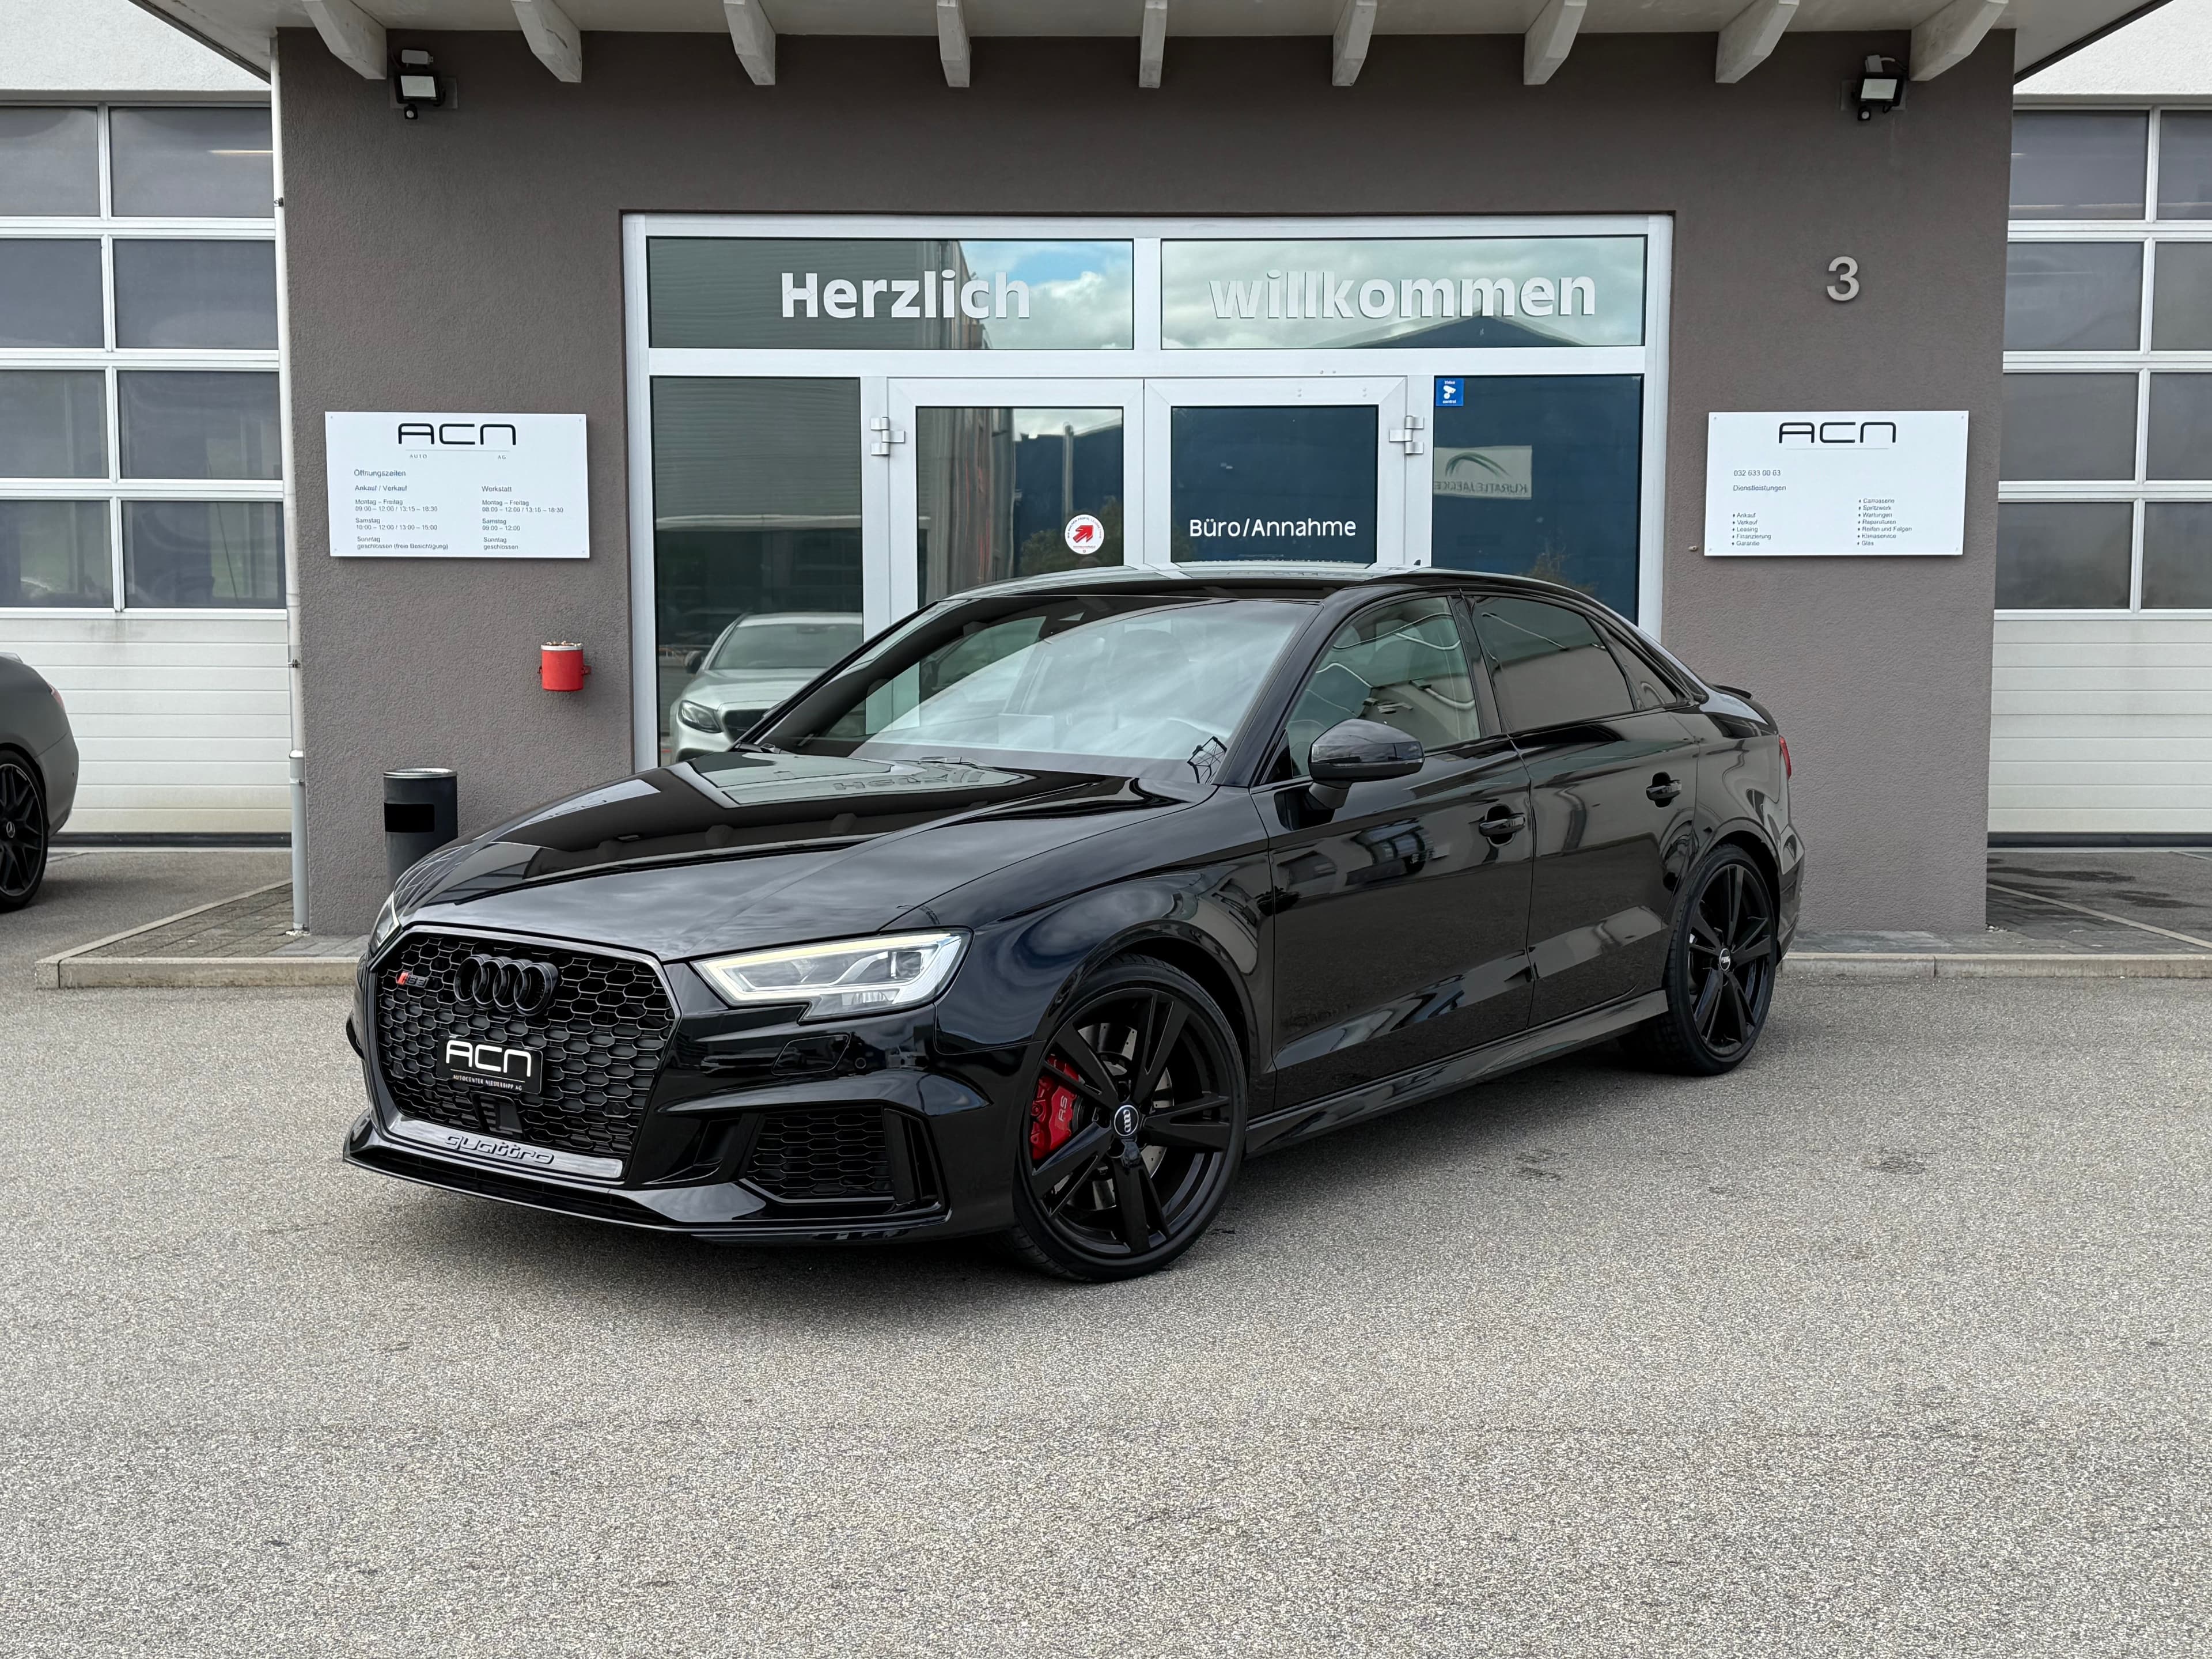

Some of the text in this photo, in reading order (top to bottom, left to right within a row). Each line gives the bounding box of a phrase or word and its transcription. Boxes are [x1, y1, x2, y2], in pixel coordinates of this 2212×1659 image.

[1827, 256, 1859, 301] 3
[782, 269, 1595, 319] Herzlich willkommen
[398, 423, 516, 445] ACN
[1779, 421, 1896, 444] ACN
[354, 468, 406, 478] Öffnungszeiten
[1733, 484, 1786, 493] Dienstleistungen
[1190, 518, 1356, 537] Büro/Annahme
[446, 1040, 532, 1077] ACN
[453, 1074, 484, 1085] AUTOCENTER
[1058, 1096, 1067, 1122] RS
[445, 1135, 555, 1165] quattro
